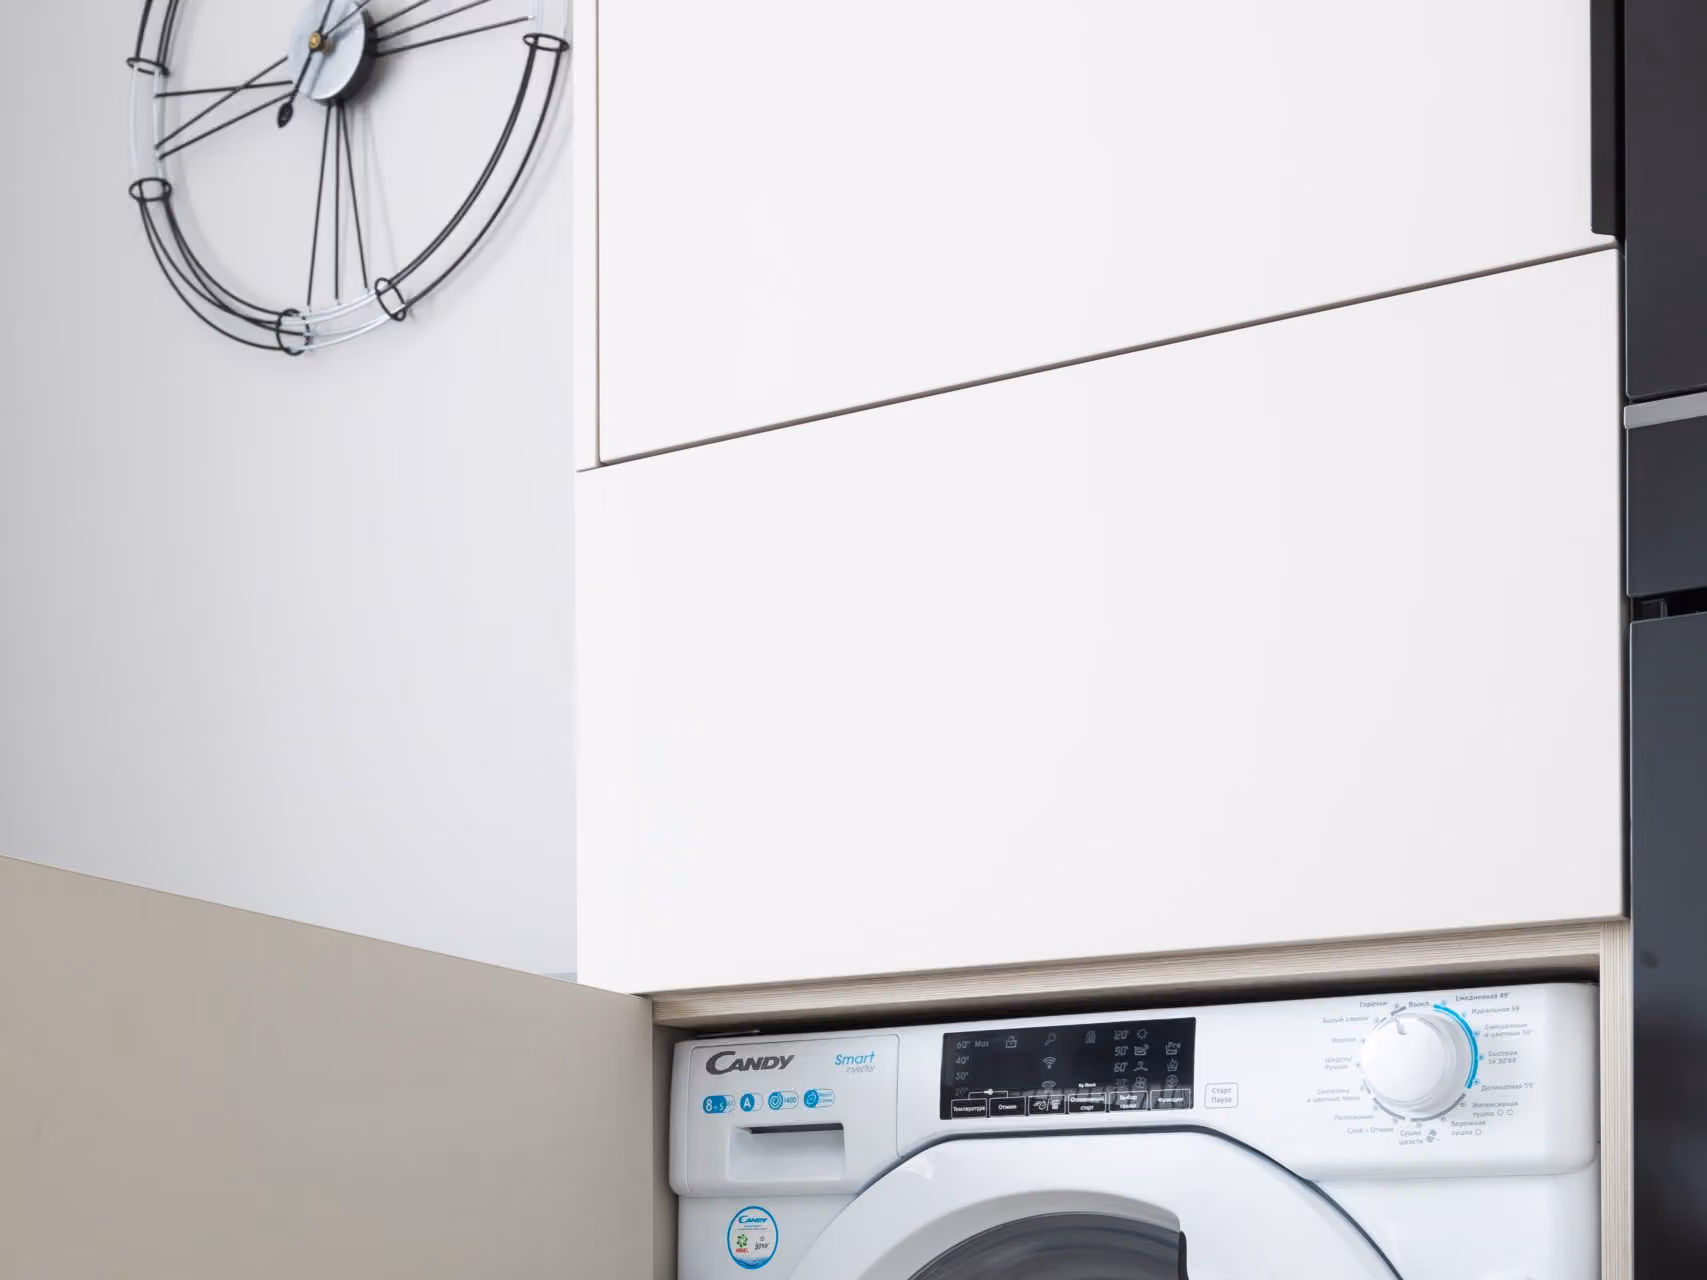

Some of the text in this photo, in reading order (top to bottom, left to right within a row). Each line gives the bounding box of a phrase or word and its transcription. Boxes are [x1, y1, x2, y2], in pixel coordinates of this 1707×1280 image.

[834, 1051, 877, 1066] Smart
[1211, 1086, 1232, 1096] Старт
[1211, 1096, 1232, 1104] Пауза
